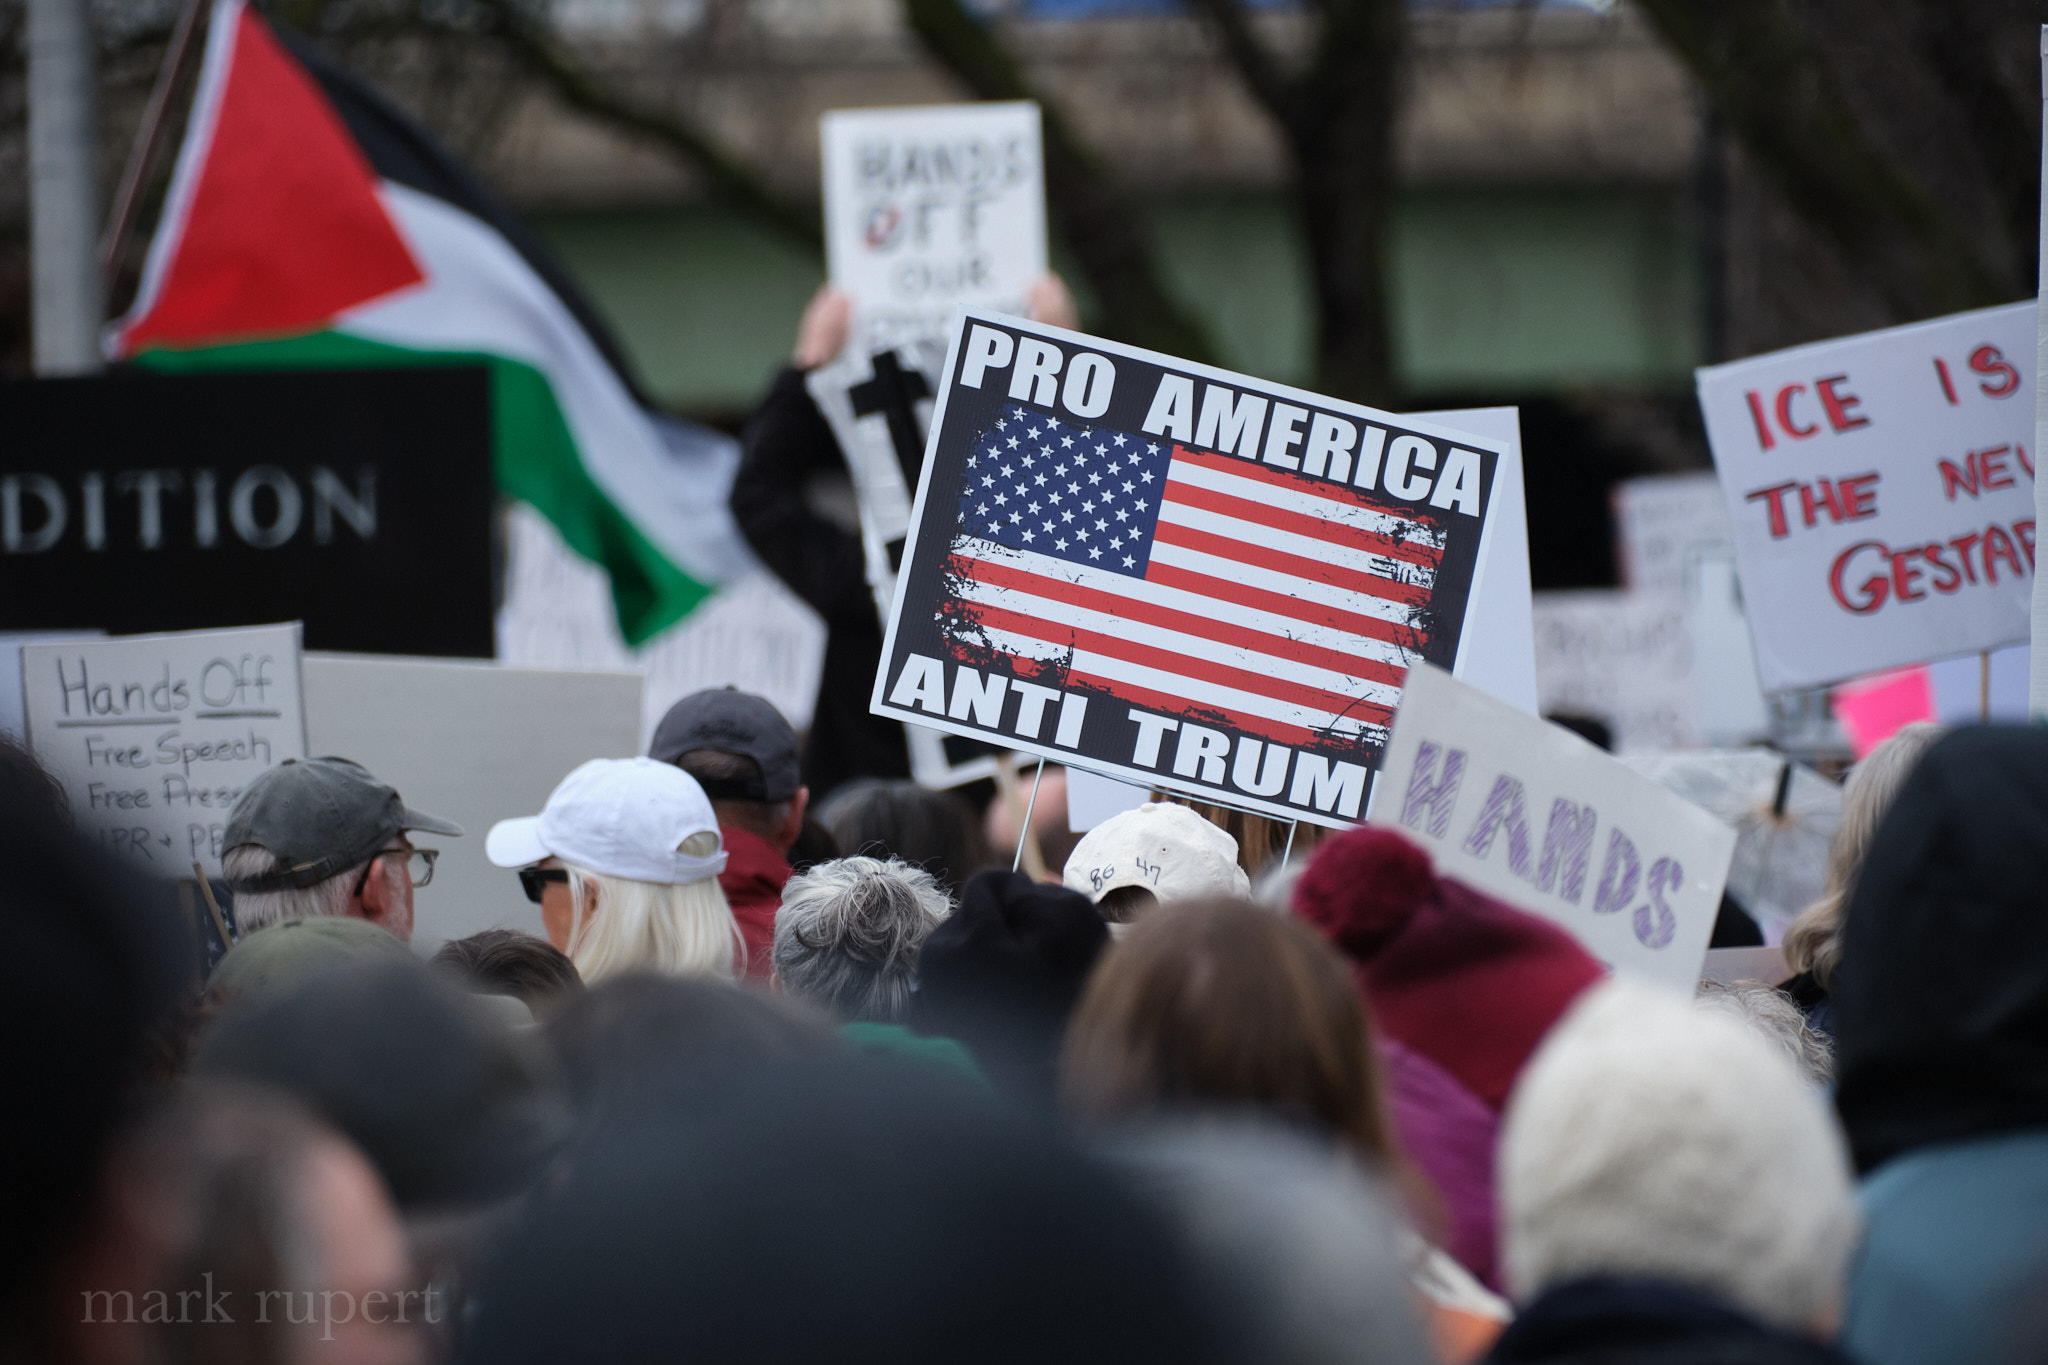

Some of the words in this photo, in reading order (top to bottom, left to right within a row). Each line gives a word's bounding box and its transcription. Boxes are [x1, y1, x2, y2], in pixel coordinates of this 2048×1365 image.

[854, 133, 1029, 192] HANDS
[960, 324, 1116, 418] PRO
[1142, 374, 1481, 517] AMERICA
[1746, 374, 1871, 450] ICE
[1933, 341, 2021, 406] IS
[1745, 471, 1881, 541] THE
[56, 655, 190, 716] Hands
[201, 653, 274, 707] Off
[86, 735, 151, 768] Free
[155, 729, 271, 778] Speech
[889, 654, 1089, 749] ANTI
[1128, 709, 1382, 821] TRUM
[88, 782, 151, 809] Free
[1090, 864, 1115, 892] 86
[1136, 857, 1161, 885] 47
[1400, 740, 1684, 950] HANDS
